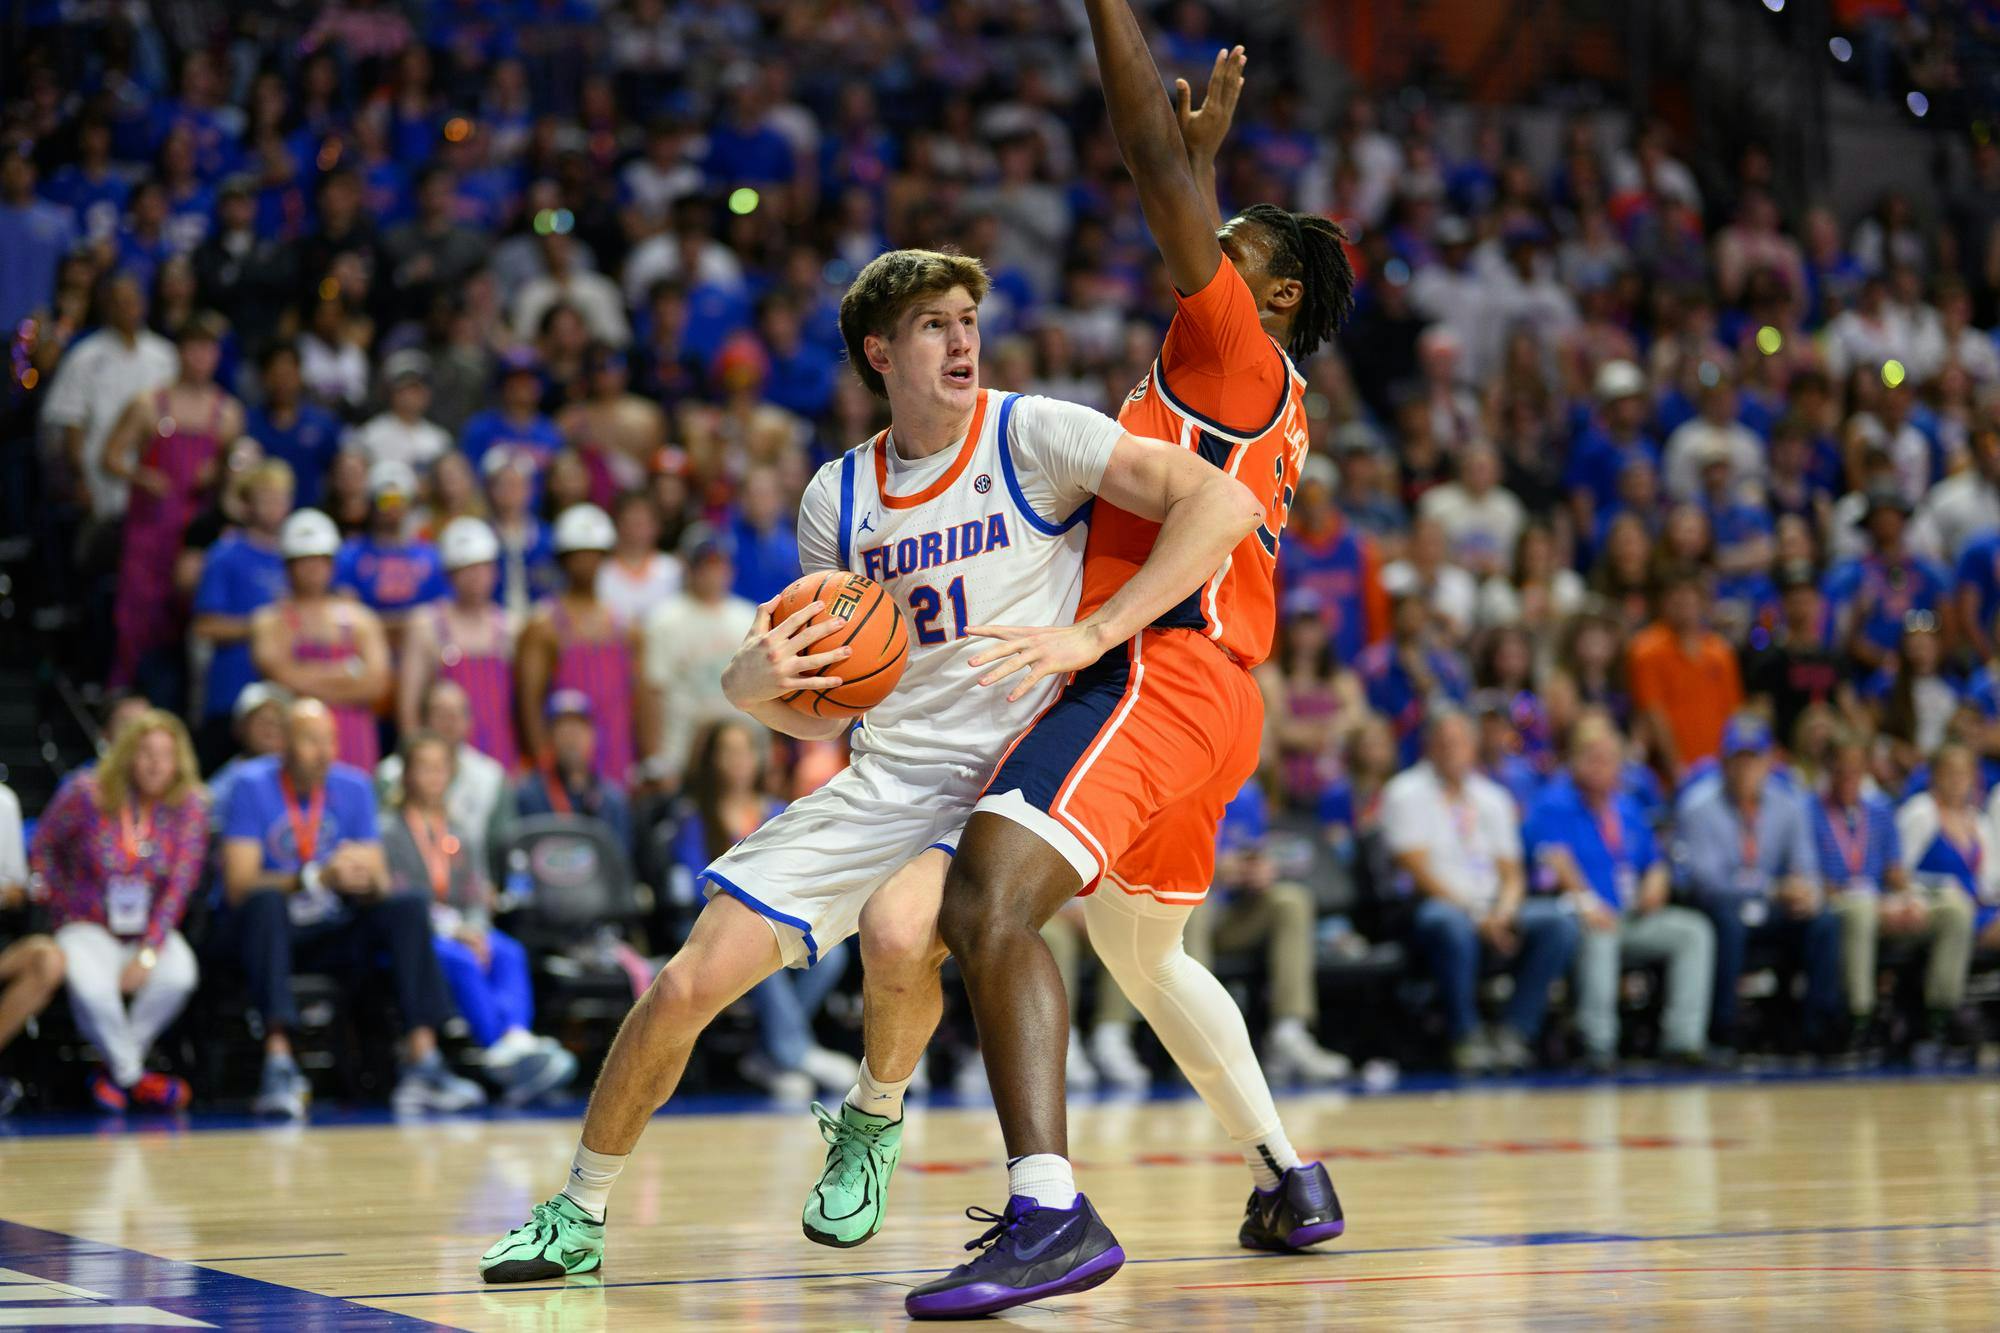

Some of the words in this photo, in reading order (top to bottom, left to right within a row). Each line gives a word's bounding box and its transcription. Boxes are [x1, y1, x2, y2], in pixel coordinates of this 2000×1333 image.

[976, 475, 991, 492] SEC
[861, 512, 1010, 583] FLORIDA
[908, 575, 968, 645] 21
